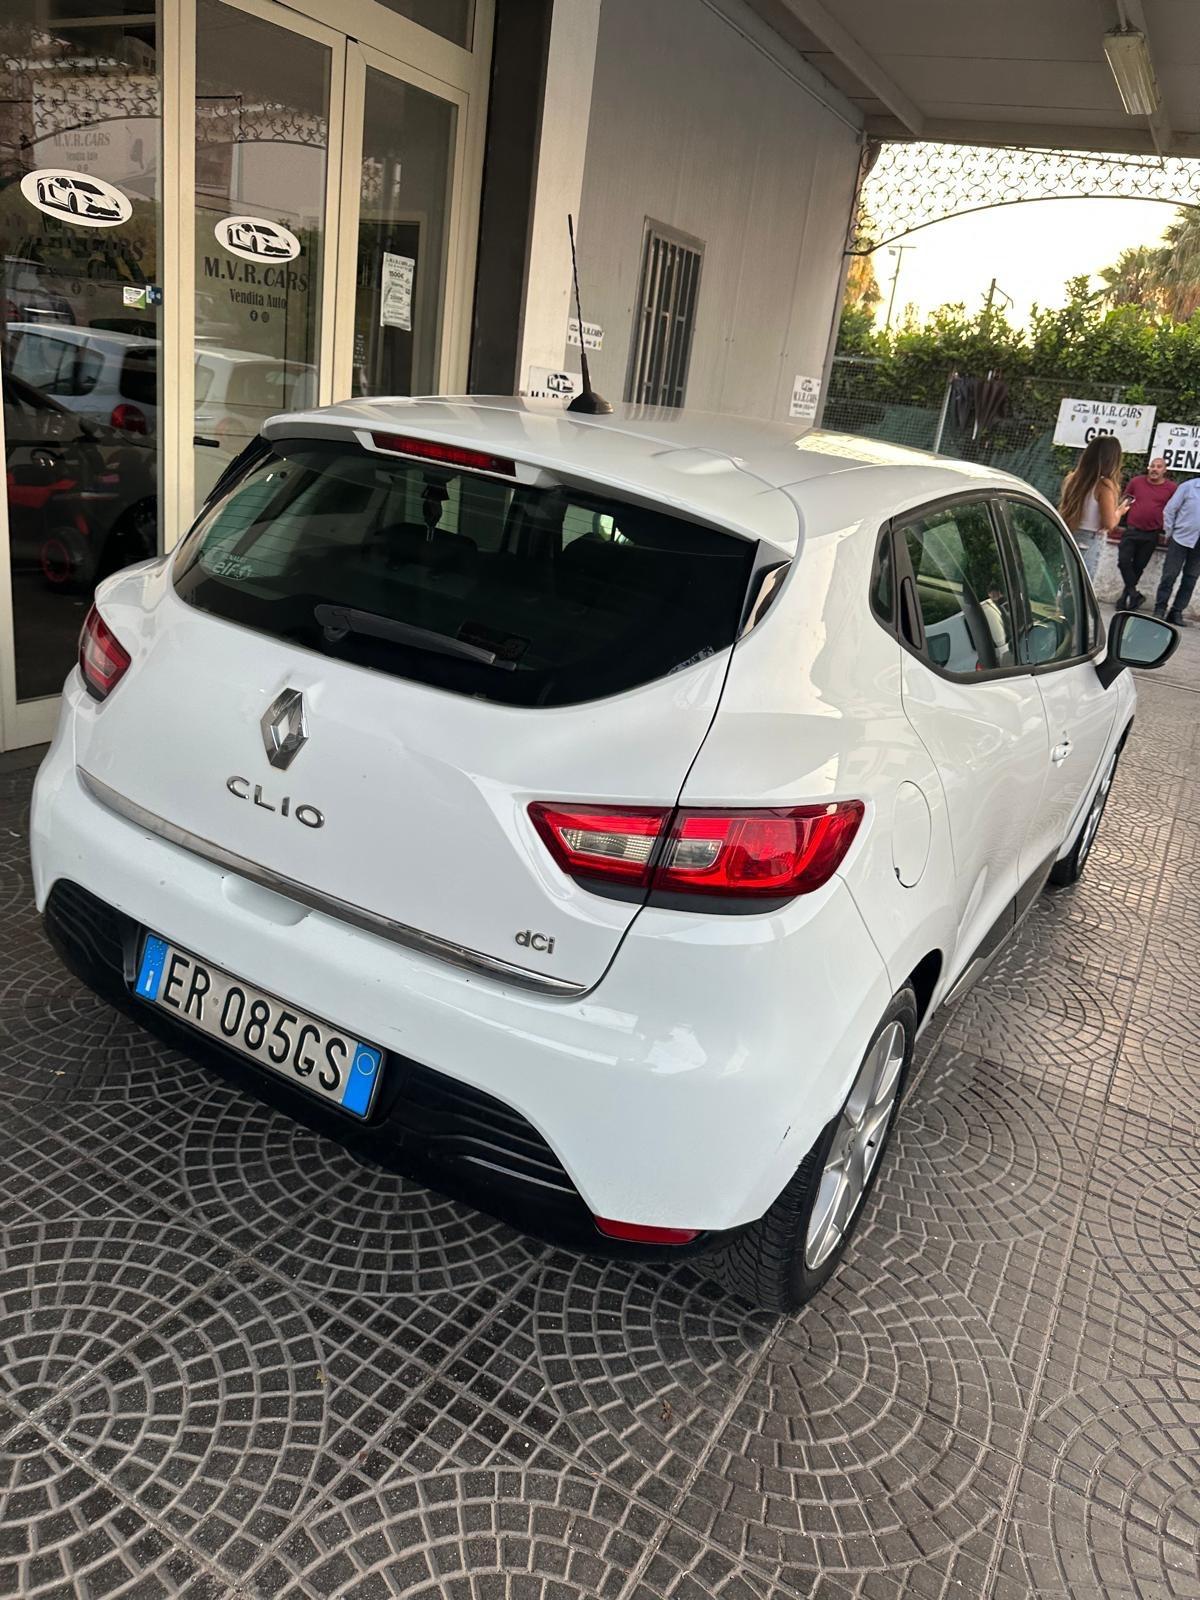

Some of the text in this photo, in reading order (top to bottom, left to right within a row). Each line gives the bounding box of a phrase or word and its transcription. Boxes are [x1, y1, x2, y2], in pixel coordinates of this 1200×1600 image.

[229, 288, 287, 309] Vendita Auto
[226, 776, 325, 829] CLIO
[515, 930, 555, 954] dCi
